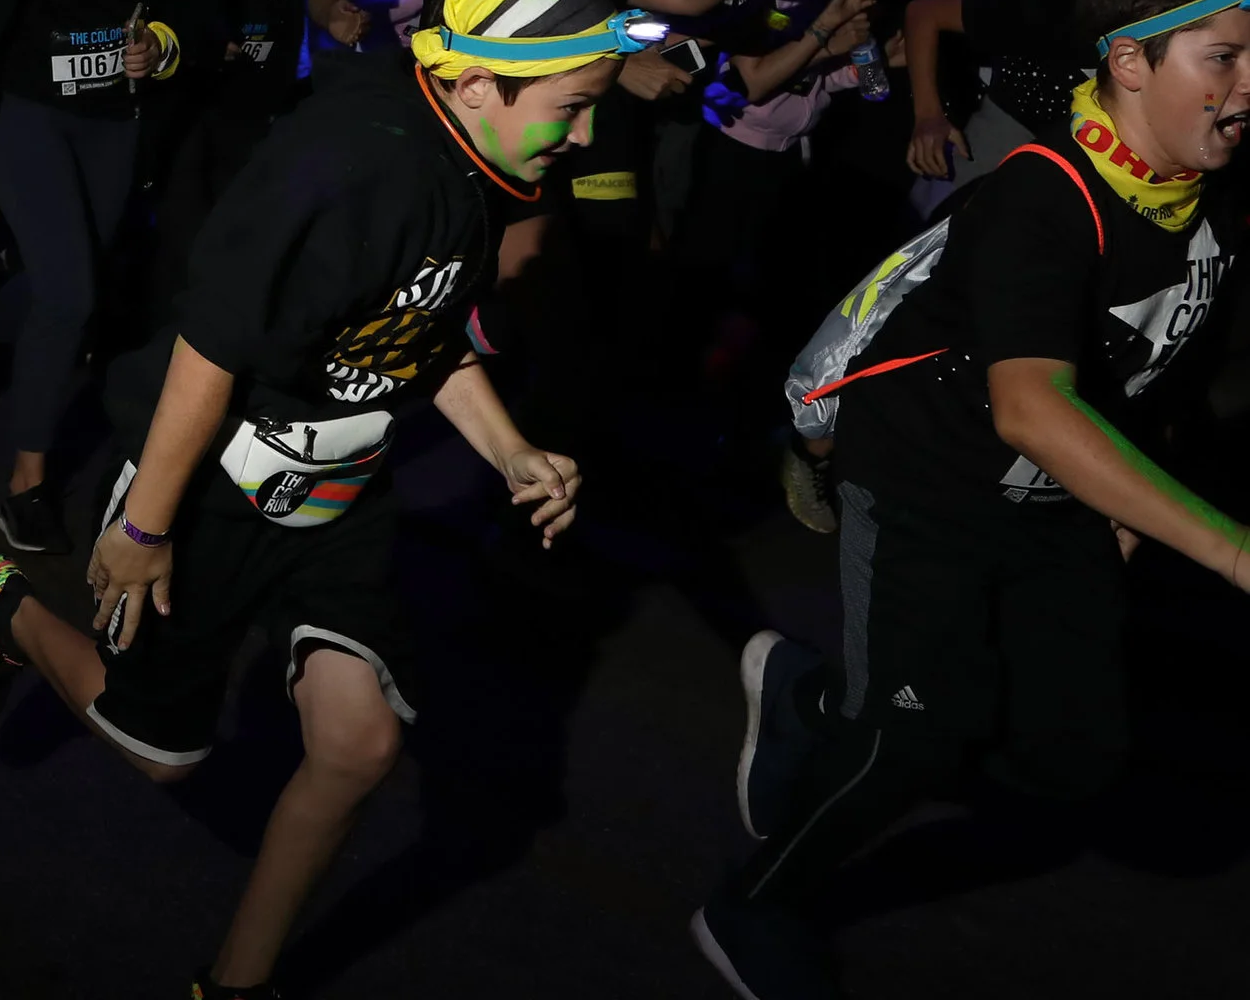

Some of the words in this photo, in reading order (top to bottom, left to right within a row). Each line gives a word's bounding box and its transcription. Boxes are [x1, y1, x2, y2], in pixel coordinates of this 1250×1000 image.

[70, 32, 89, 46] THE
[90, 27, 123, 44] COLOR
[68, 51, 120, 78] 1067
[263, 498, 292, 513] RUN.
